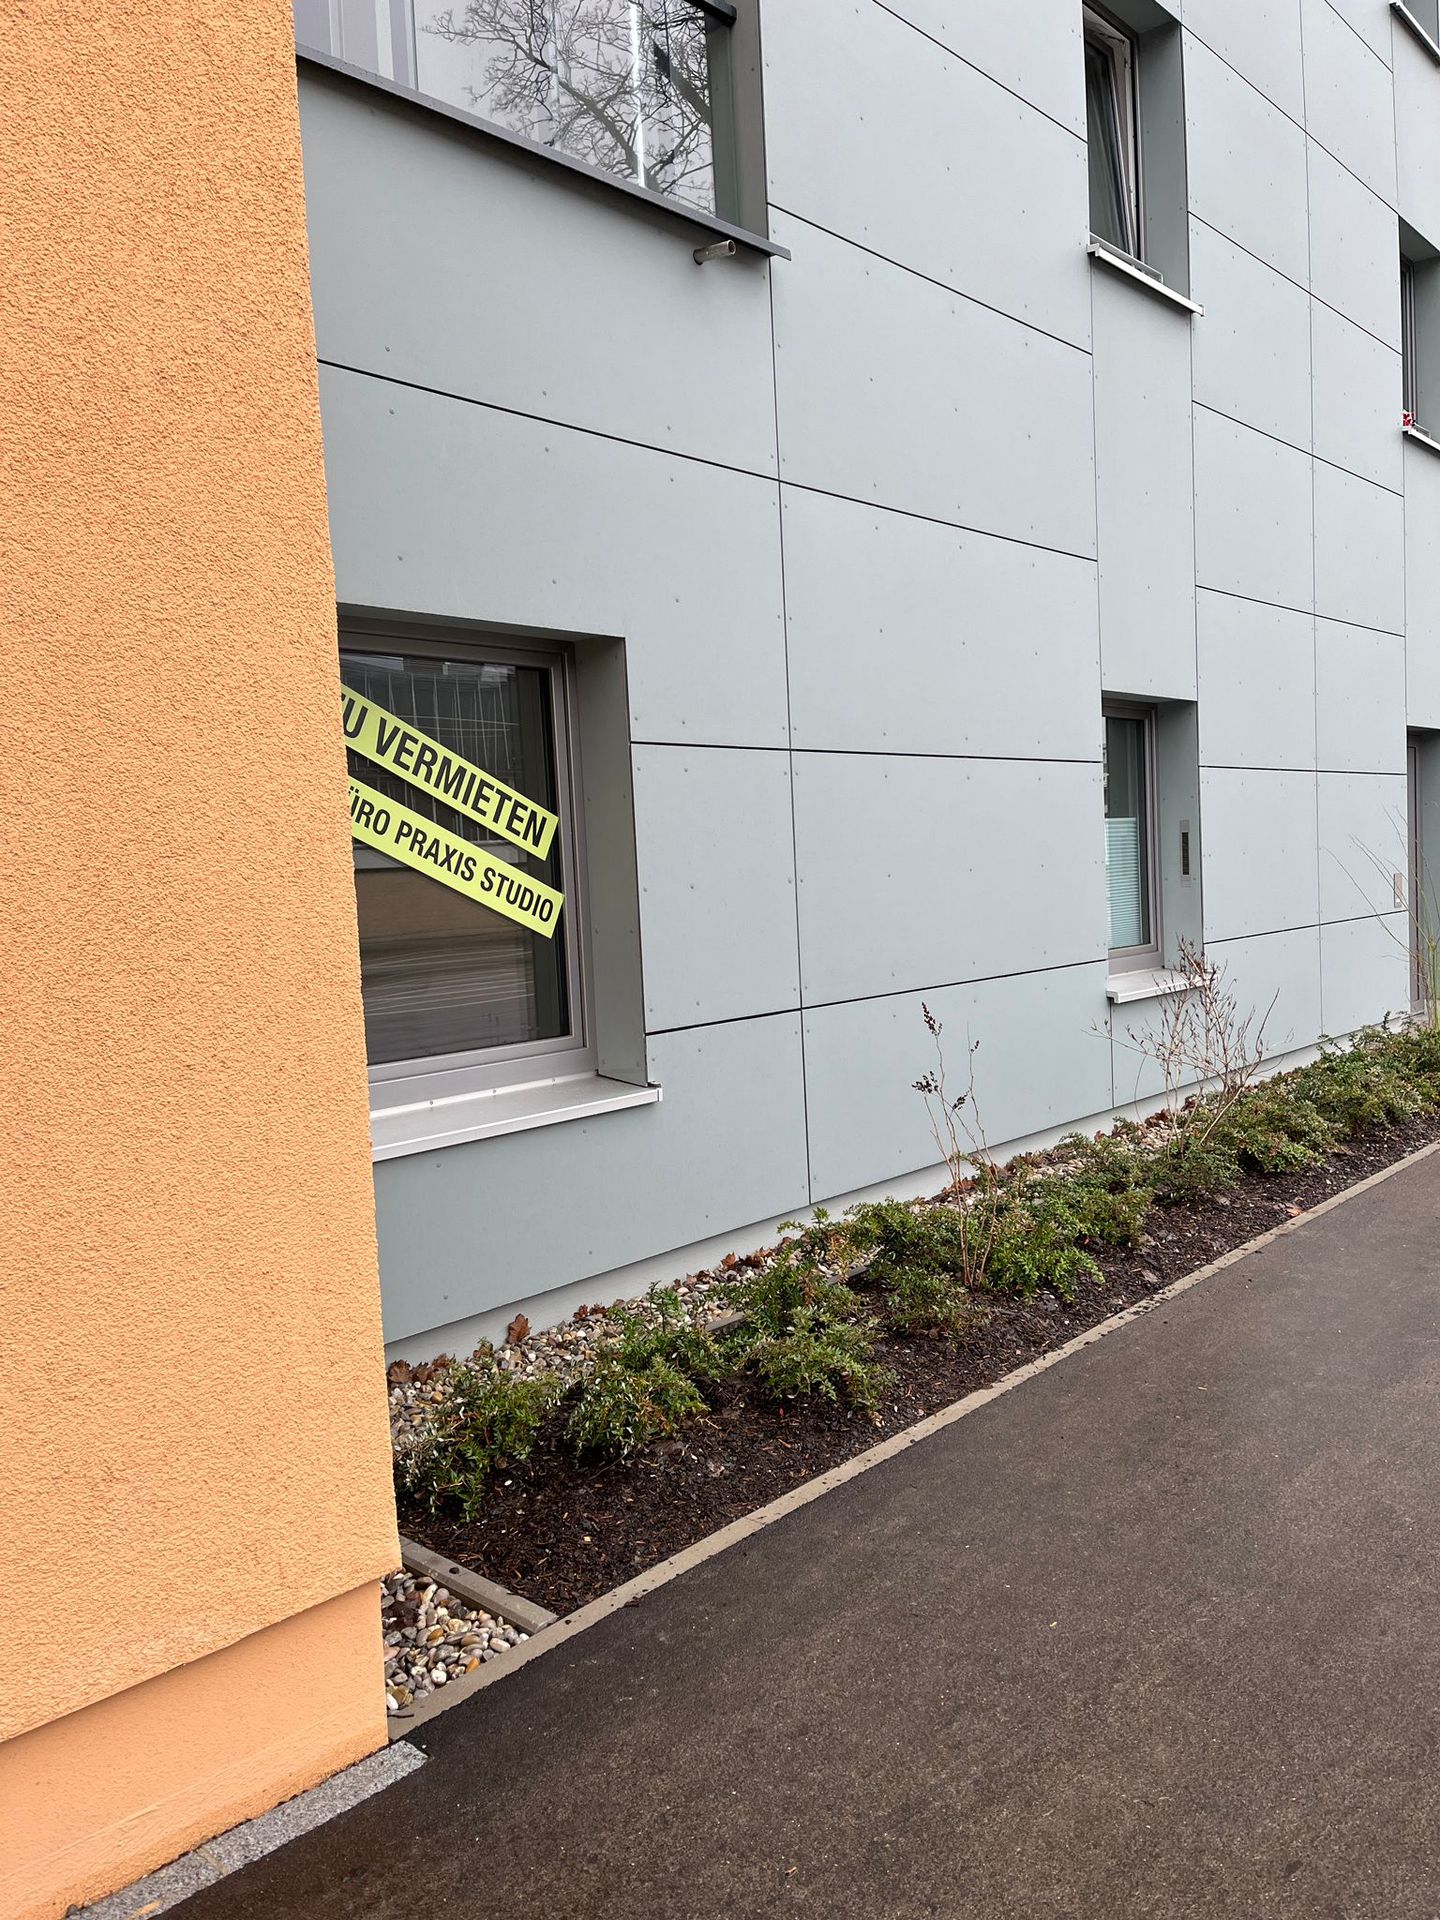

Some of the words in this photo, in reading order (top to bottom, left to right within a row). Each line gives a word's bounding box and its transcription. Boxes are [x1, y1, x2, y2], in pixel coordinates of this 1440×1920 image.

[341, 692, 368, 739] U
[375, 716, 548, 848] VERMIETEN
[394, 819, 477, 882] PRAXIS
[480, 866, 554, 923] STUDIO
